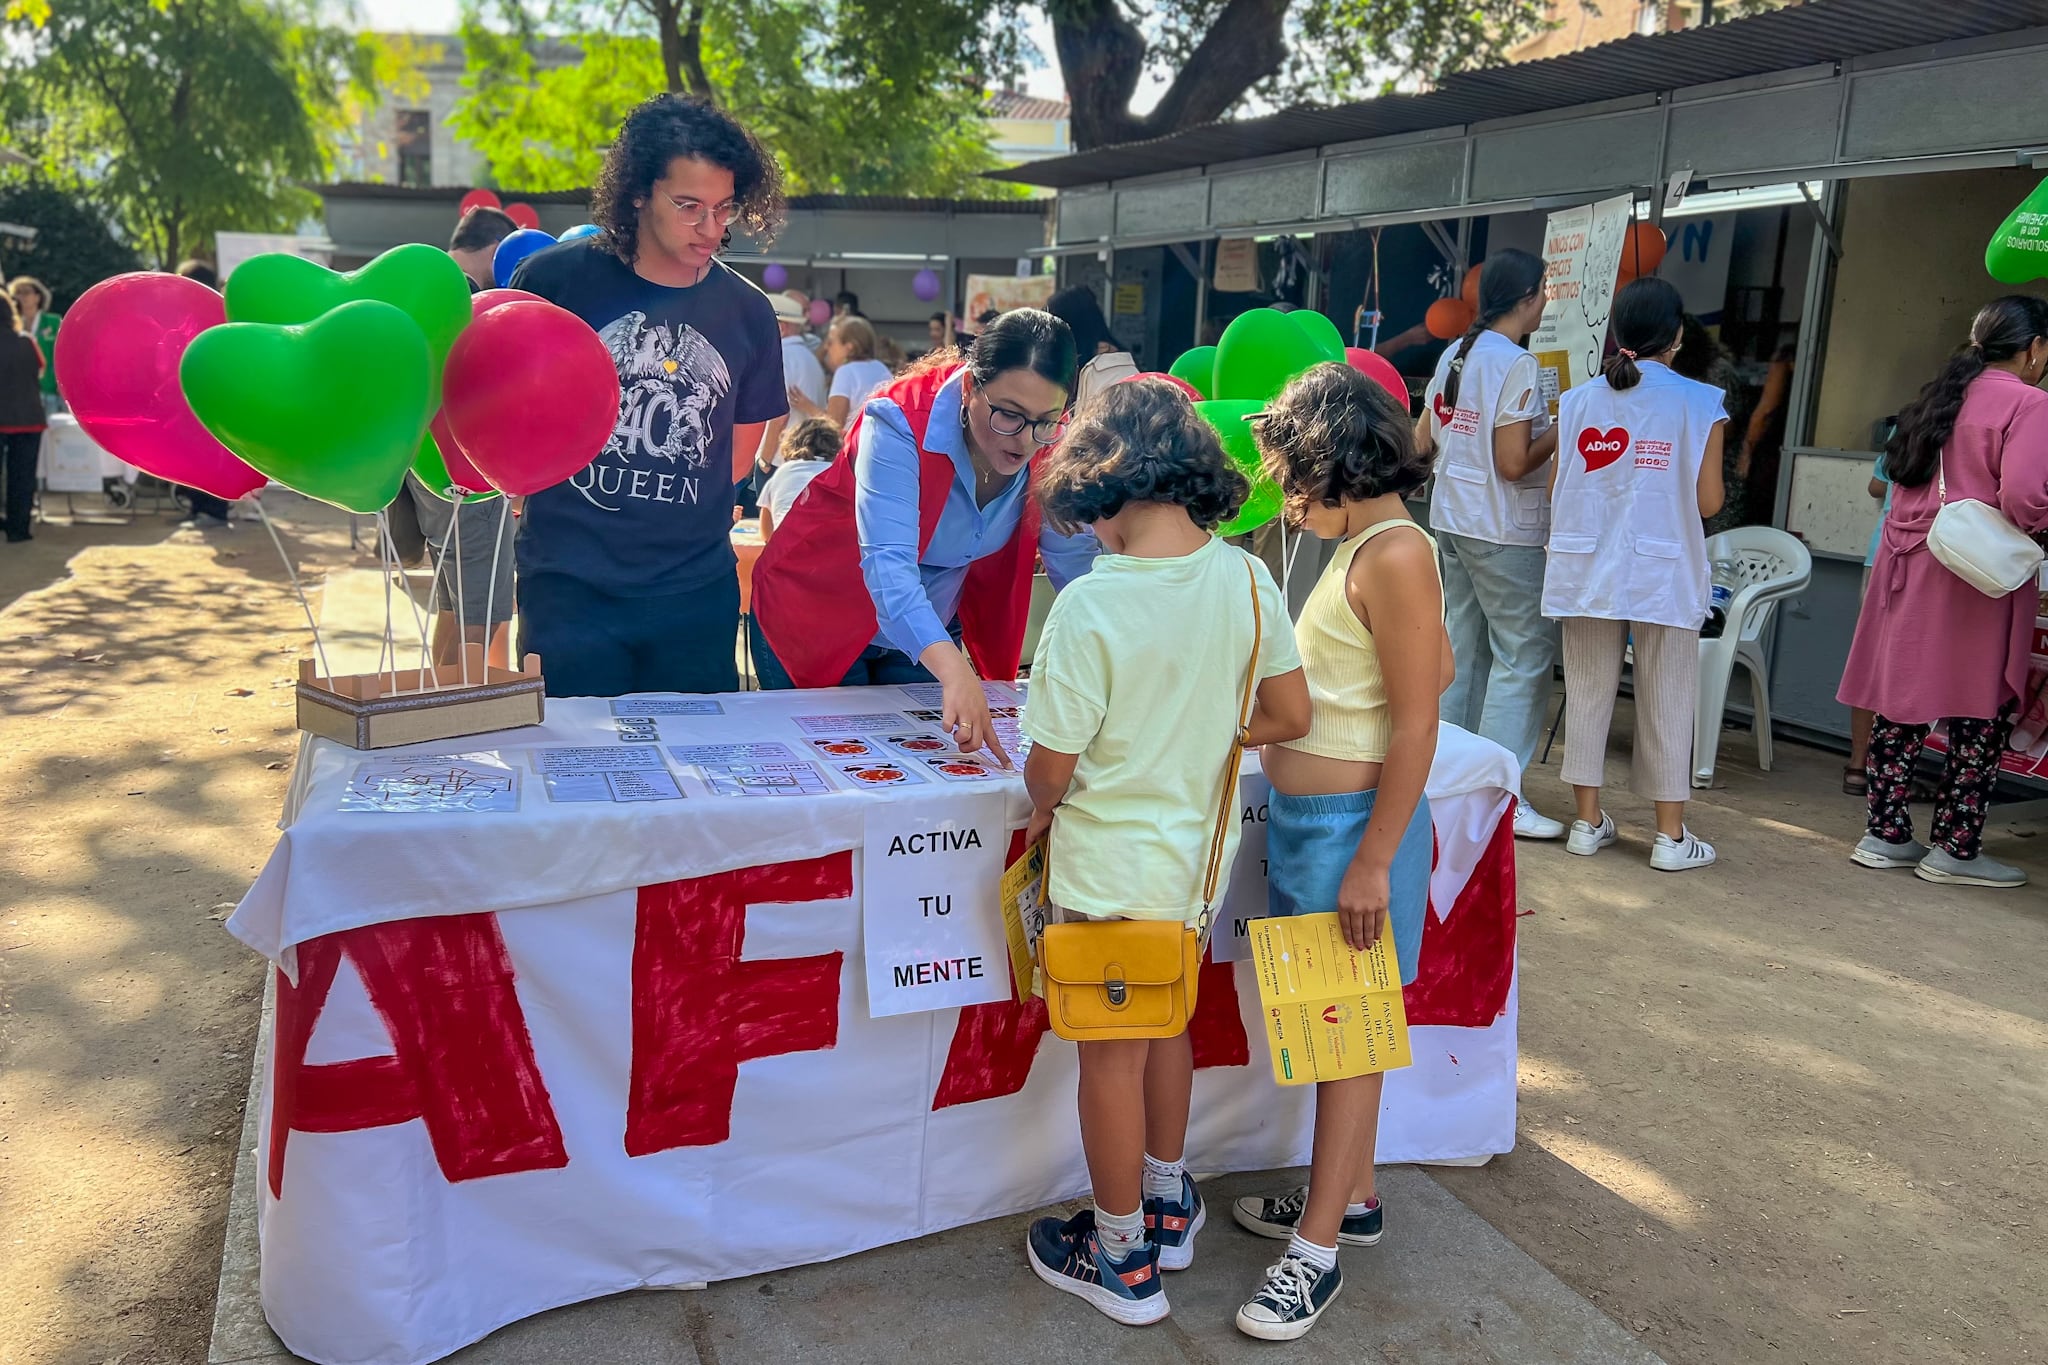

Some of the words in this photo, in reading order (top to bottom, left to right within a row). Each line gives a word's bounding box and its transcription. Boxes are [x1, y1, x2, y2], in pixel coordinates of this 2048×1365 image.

[1673, 181, 1685, 201] 4
[1545, 280, 1581, 301] OGNITIVOS
[1585, 440, 1621, 452] ADMO
[569, 463, 700, 511] QUEEN
[887, 828, 983, 857] ACTIVA
[918, 895, 952, 917] TU
[893, 956, 984, 988] MENTE
[1360, 994, 1377, 1067] VOLUNTARIADO
[1374, 1019, 1384, 1038] DEL
[1382, 1001, 1397, 1053] PASAPORTE
